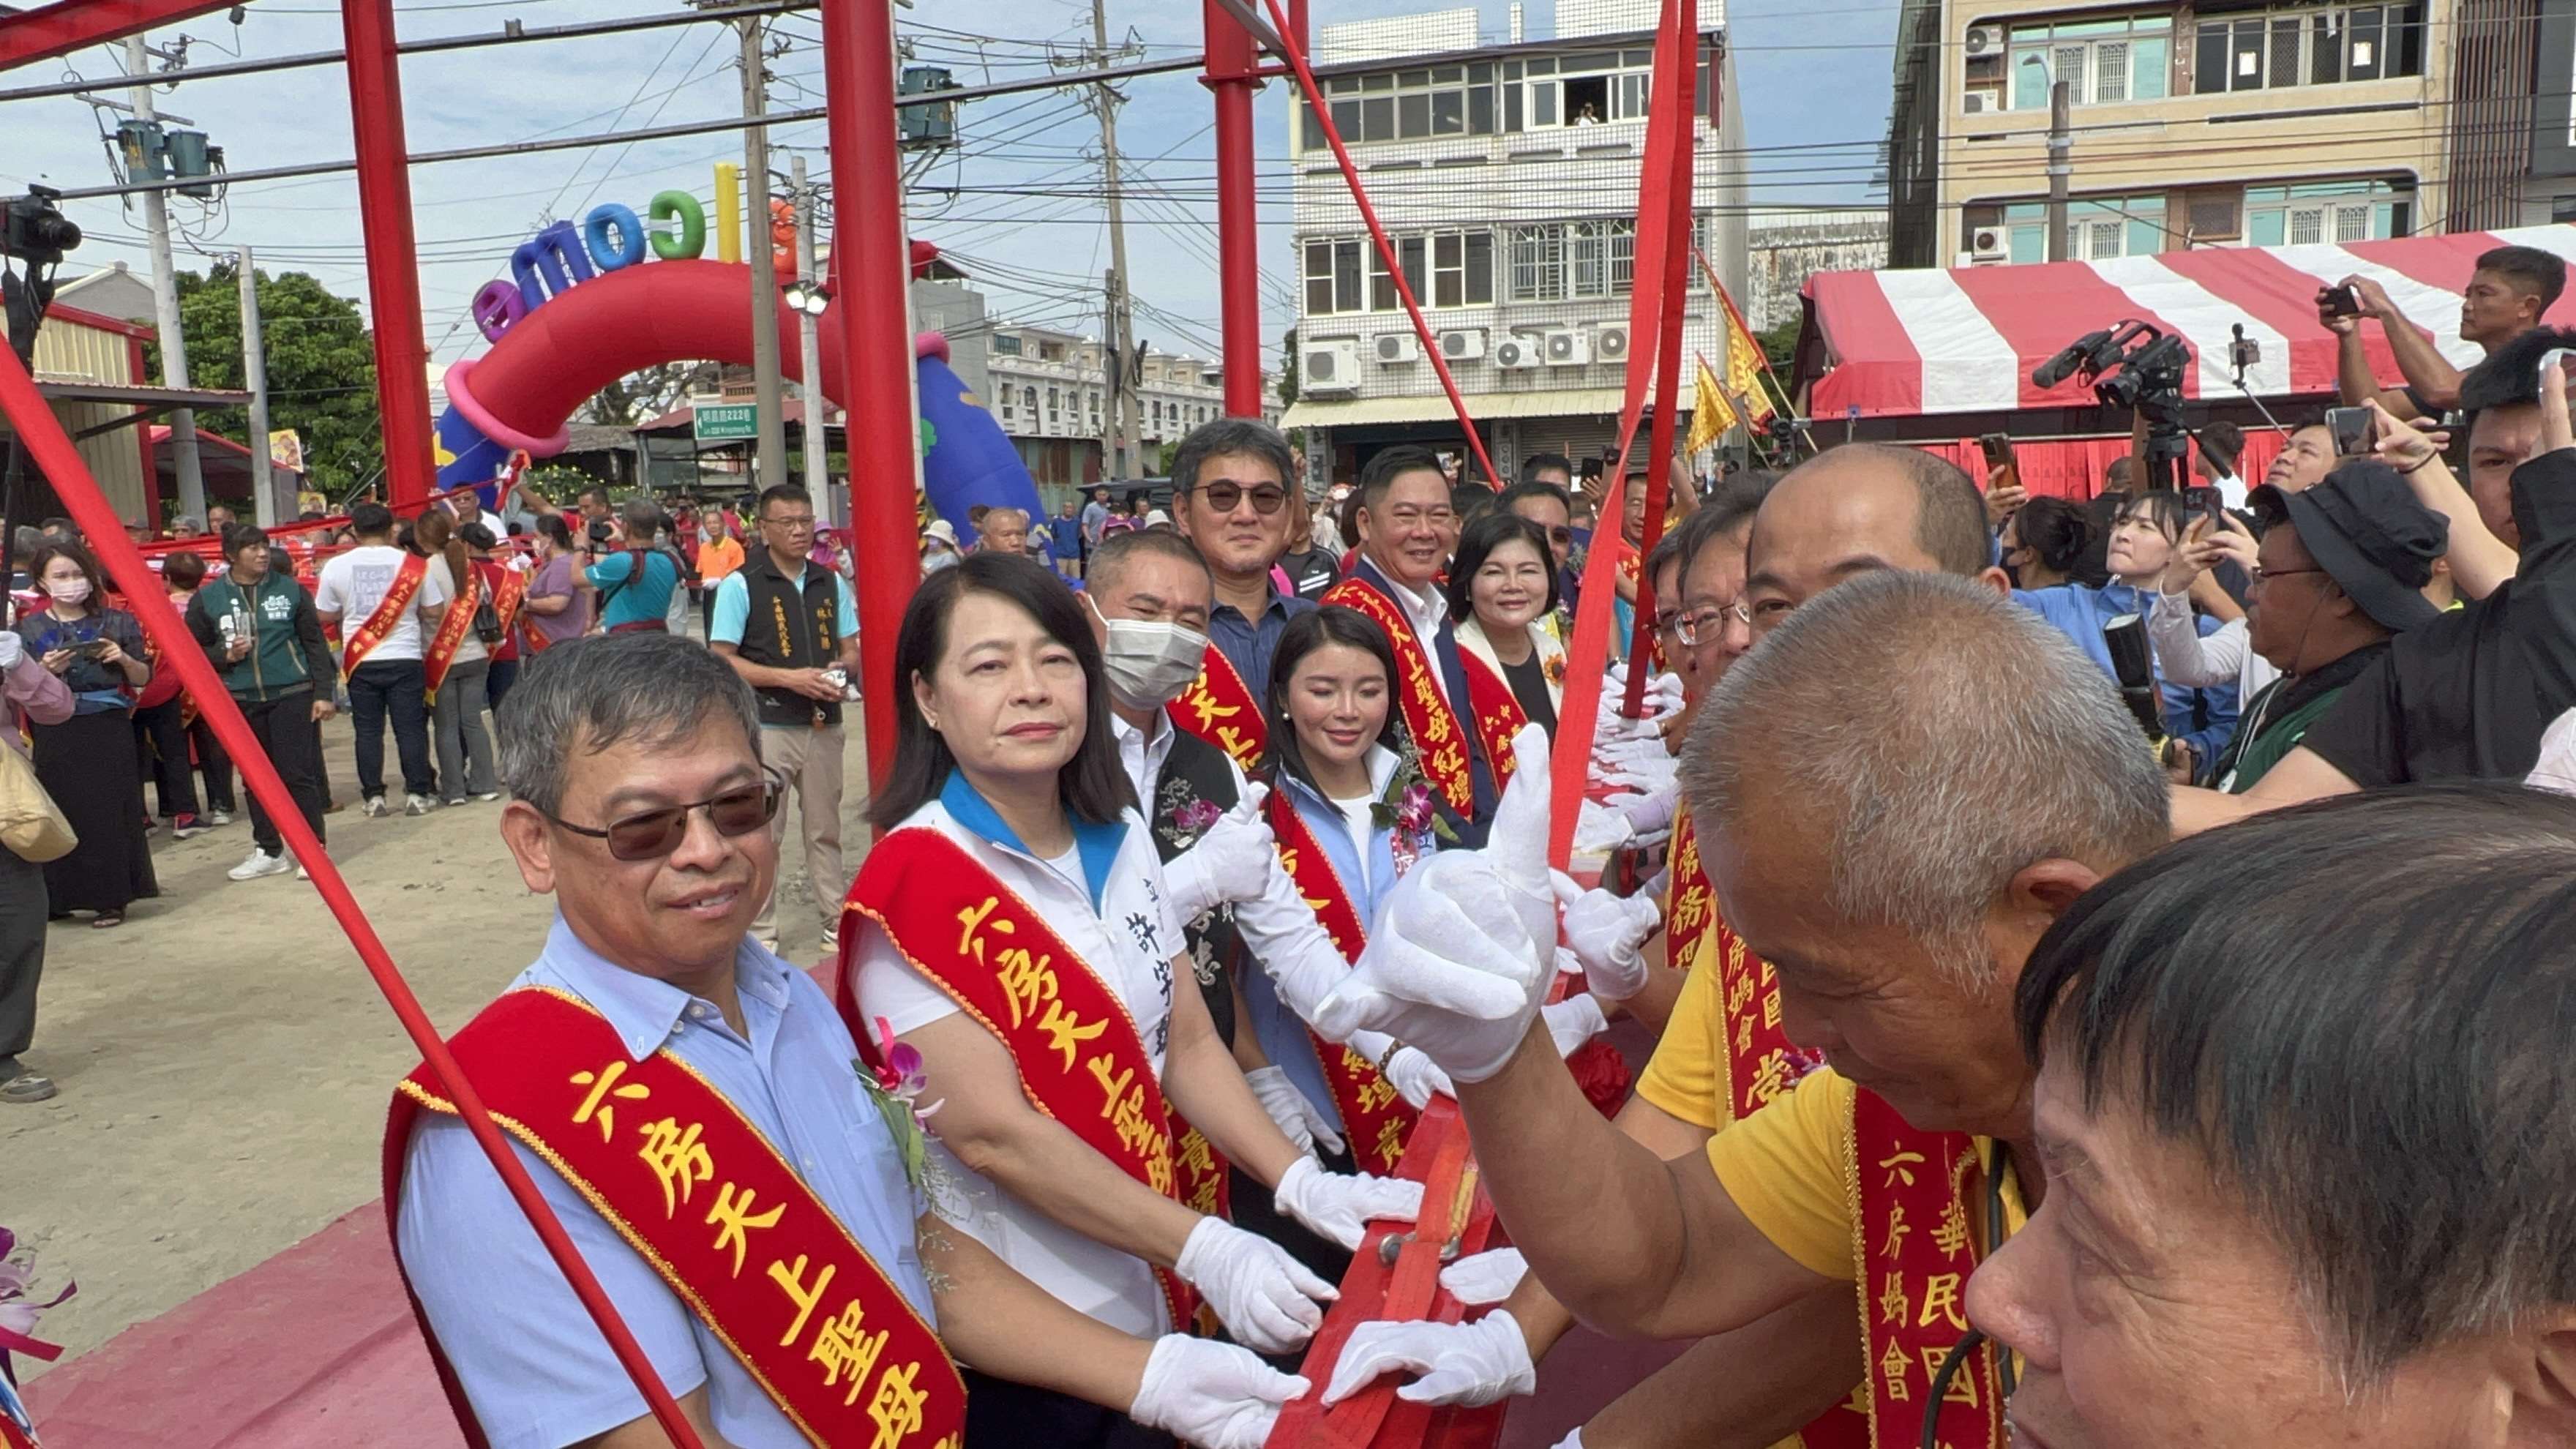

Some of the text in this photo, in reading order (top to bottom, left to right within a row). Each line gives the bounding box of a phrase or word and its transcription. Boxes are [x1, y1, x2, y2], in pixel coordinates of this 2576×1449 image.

[956, 896, 1173, 1196] 六房天上聖母
[570, 1060, 961, 1449] 六房天上聖母
[1879, 1140, 1925, 1402] 六房媽會
